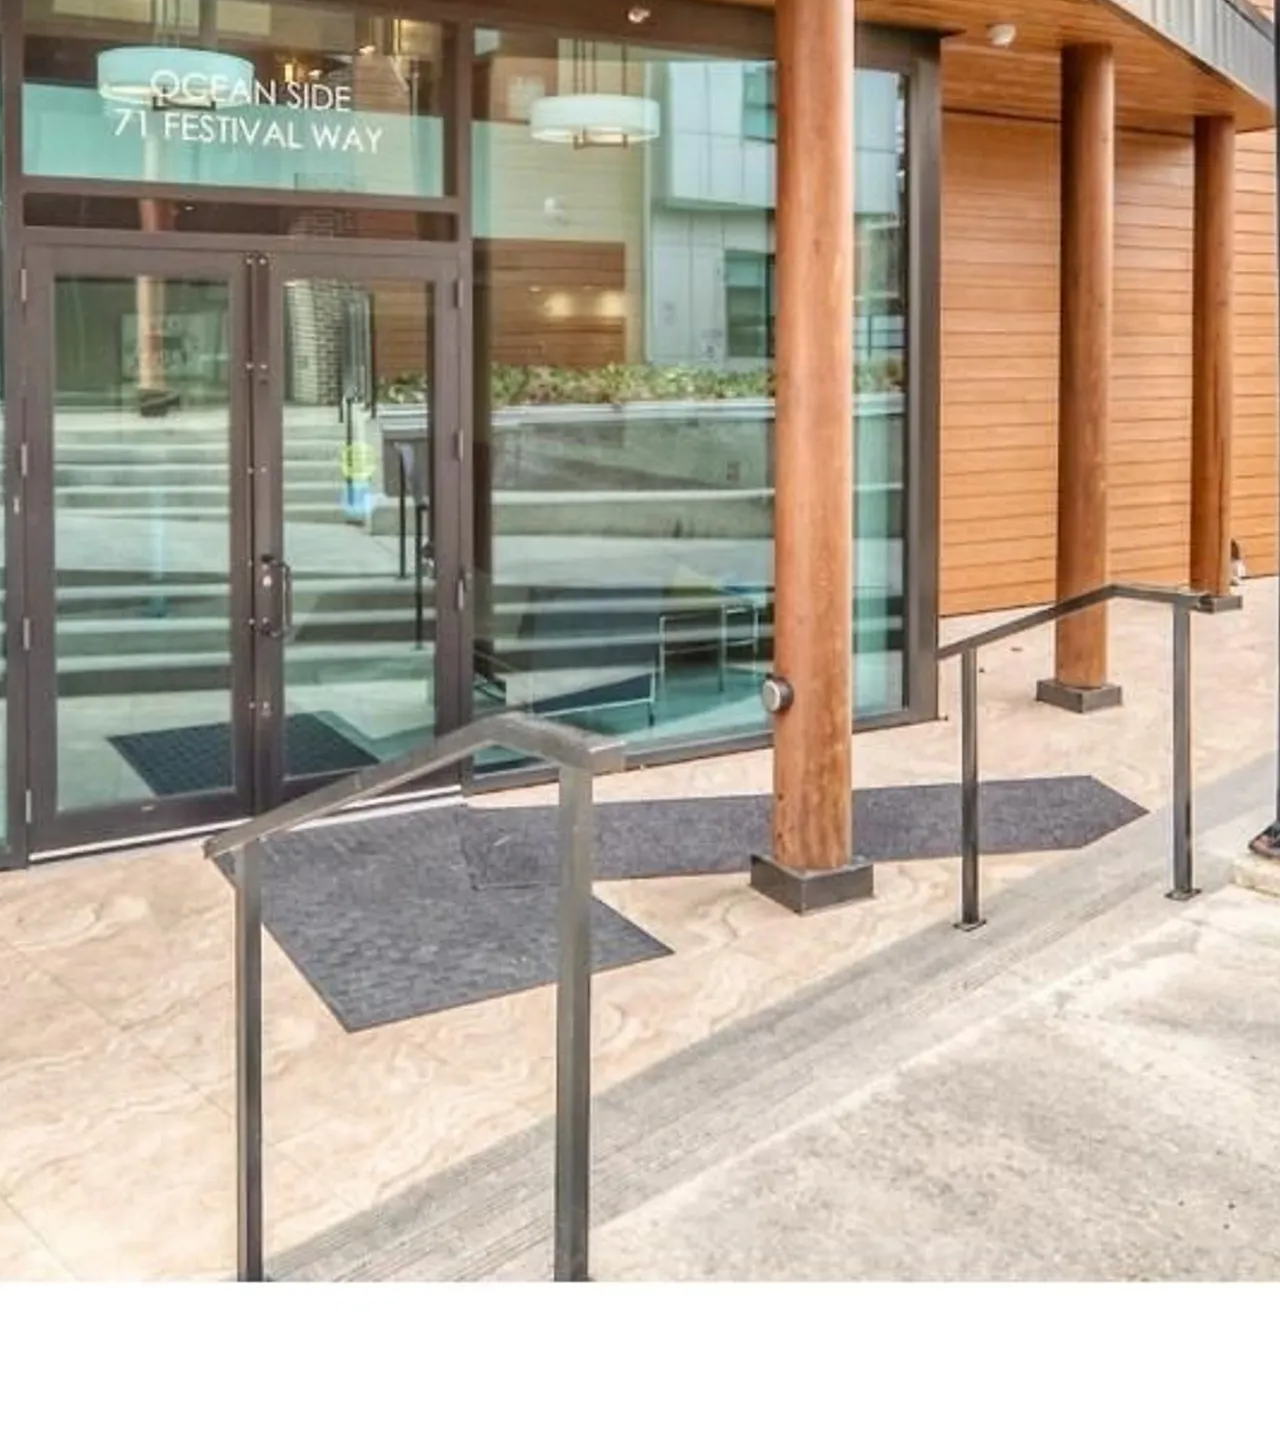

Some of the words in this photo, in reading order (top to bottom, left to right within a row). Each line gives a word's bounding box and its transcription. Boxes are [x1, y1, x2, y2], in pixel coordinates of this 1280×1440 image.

[150, 69, 277, 105] OCEAN
[286, 81, 351, 112] SIDE
[113, 108, 147, 137] 71
[164, 111, 303, 149] FESTIVAL
[310, 122, 383, 154] WAY
